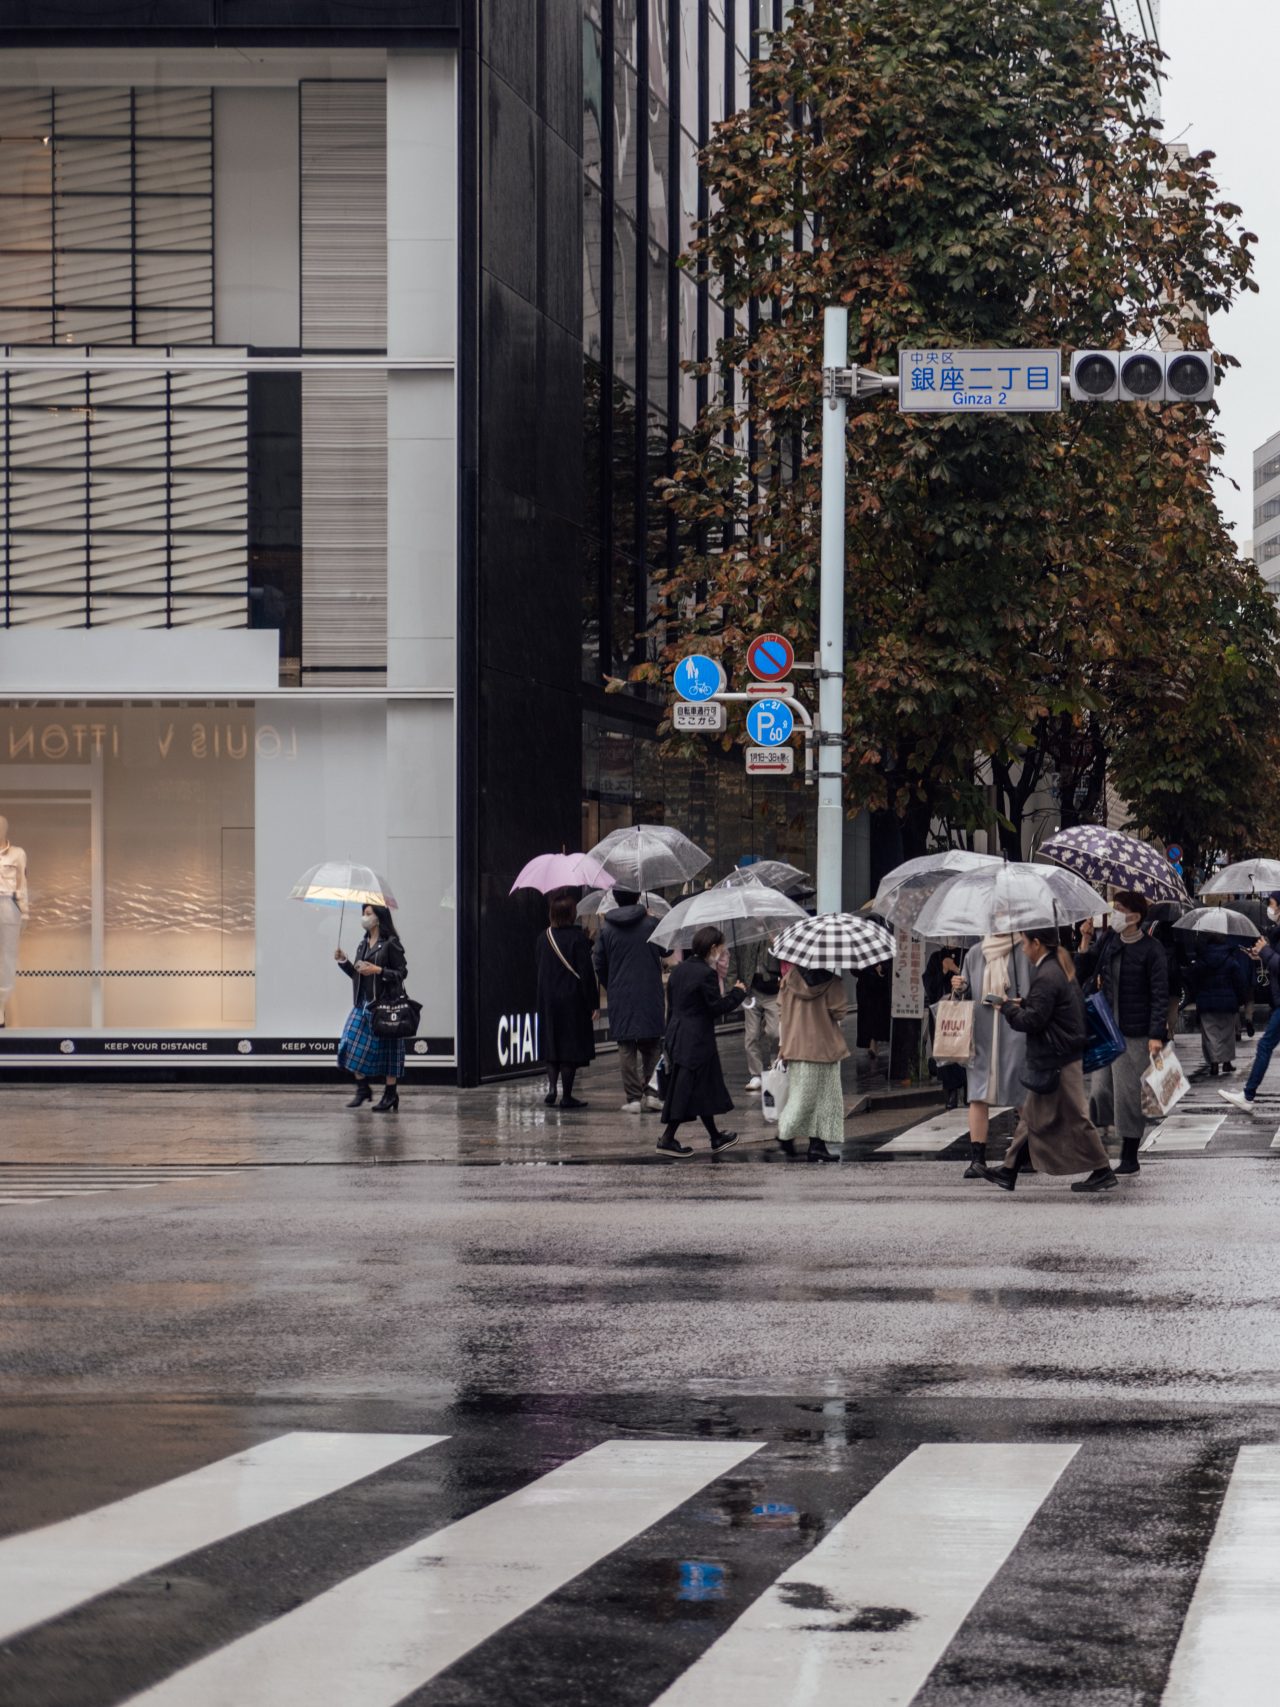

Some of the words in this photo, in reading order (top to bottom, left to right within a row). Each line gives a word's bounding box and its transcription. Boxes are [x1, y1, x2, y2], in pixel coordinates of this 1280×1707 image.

[910, 352, 953, 364] 中央区
[911, 367, 1049, 391] 銀座二丁目
[953, 392, 992, 405] Ginza
[998, 392, 1007, 405] 2
[678, 717, 717, 726] ここから
[757, 712, 775, 742] P
[941, 1020, 966, 1031] MUJI
[497, 1011, 538, 1066] CHA
[104, 1043, 129, 1051] KEEP
[132, 1043, 158, 1051] YOUR
[161, 1043, 208, 1051] DISTANCE
[281, 1043, 306, 1051] KEEP
[309, 1042, 335, 1051] YOUR
